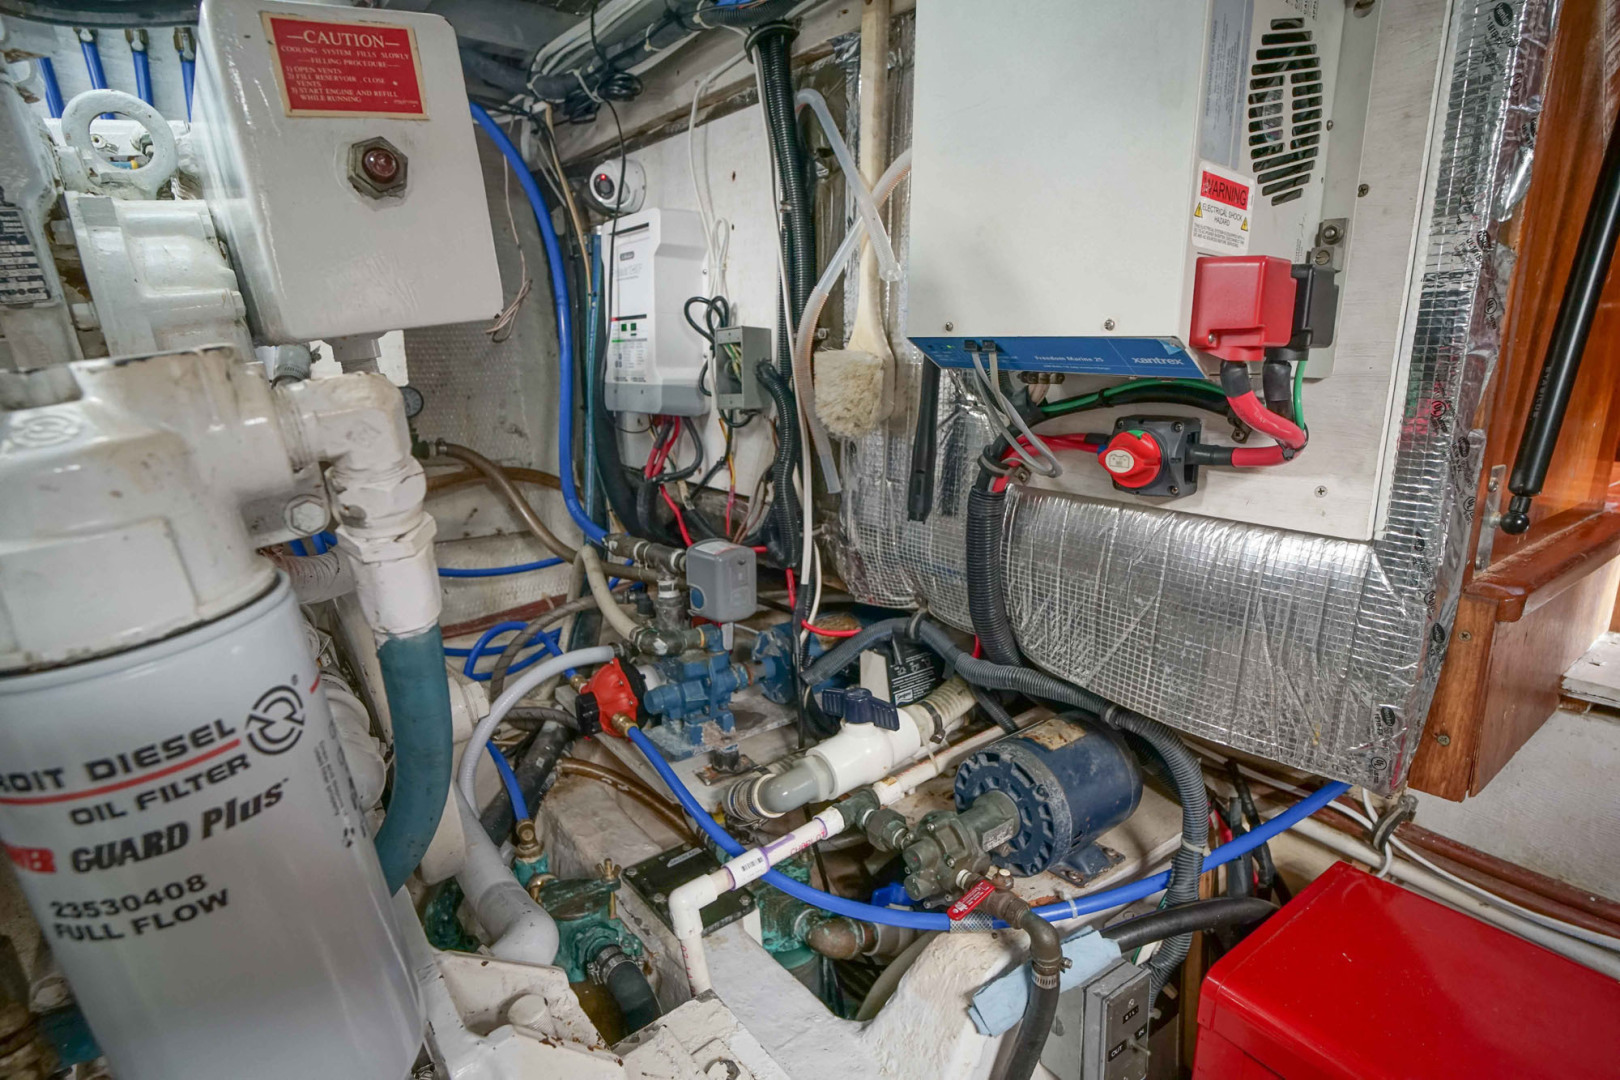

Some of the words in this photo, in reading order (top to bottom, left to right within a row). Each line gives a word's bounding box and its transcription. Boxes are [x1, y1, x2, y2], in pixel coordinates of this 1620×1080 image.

[303, 30, 386, 48] CAUTION
[280, 45, 318, 54] COOLING
[322, 48, 352, 57] SYSTEM
[356, 50, 377, 58] FILLS
[380, 51, 410, 60] SLOWLY
[310, 57, 342, 65] FILLING
[343, 59, 387, 68] PROCEDURE
[299, 94, 326, 102] WHILE
[326, 95, 362, 103] RUNNING
[325, 88, 354, 96] ENGINE
[1202, 175, 1247, 206] WARNING
[1202, 203, 1228, 218] ELECTRICAL
[1228, 211, 1243, 222] SHOCK
[1214, 216, 1231, 227] HAZARD
[1132, 356, 1184, 365] xantrex
[84, 718, 236, 782] DIESEL
[69, 800, 128, 826] OIL
[135, 753, 252, 812] FILTER
[70, 820, 190, 875] GUARD
[201, 782, 286, 841] Plus
[51, 873, 208, 920] 23530408
[53, 922, 125, 941] FULL
[131, 887, 230, 936] FLOW
[1111, 1045, 1123, 1057] OUT
